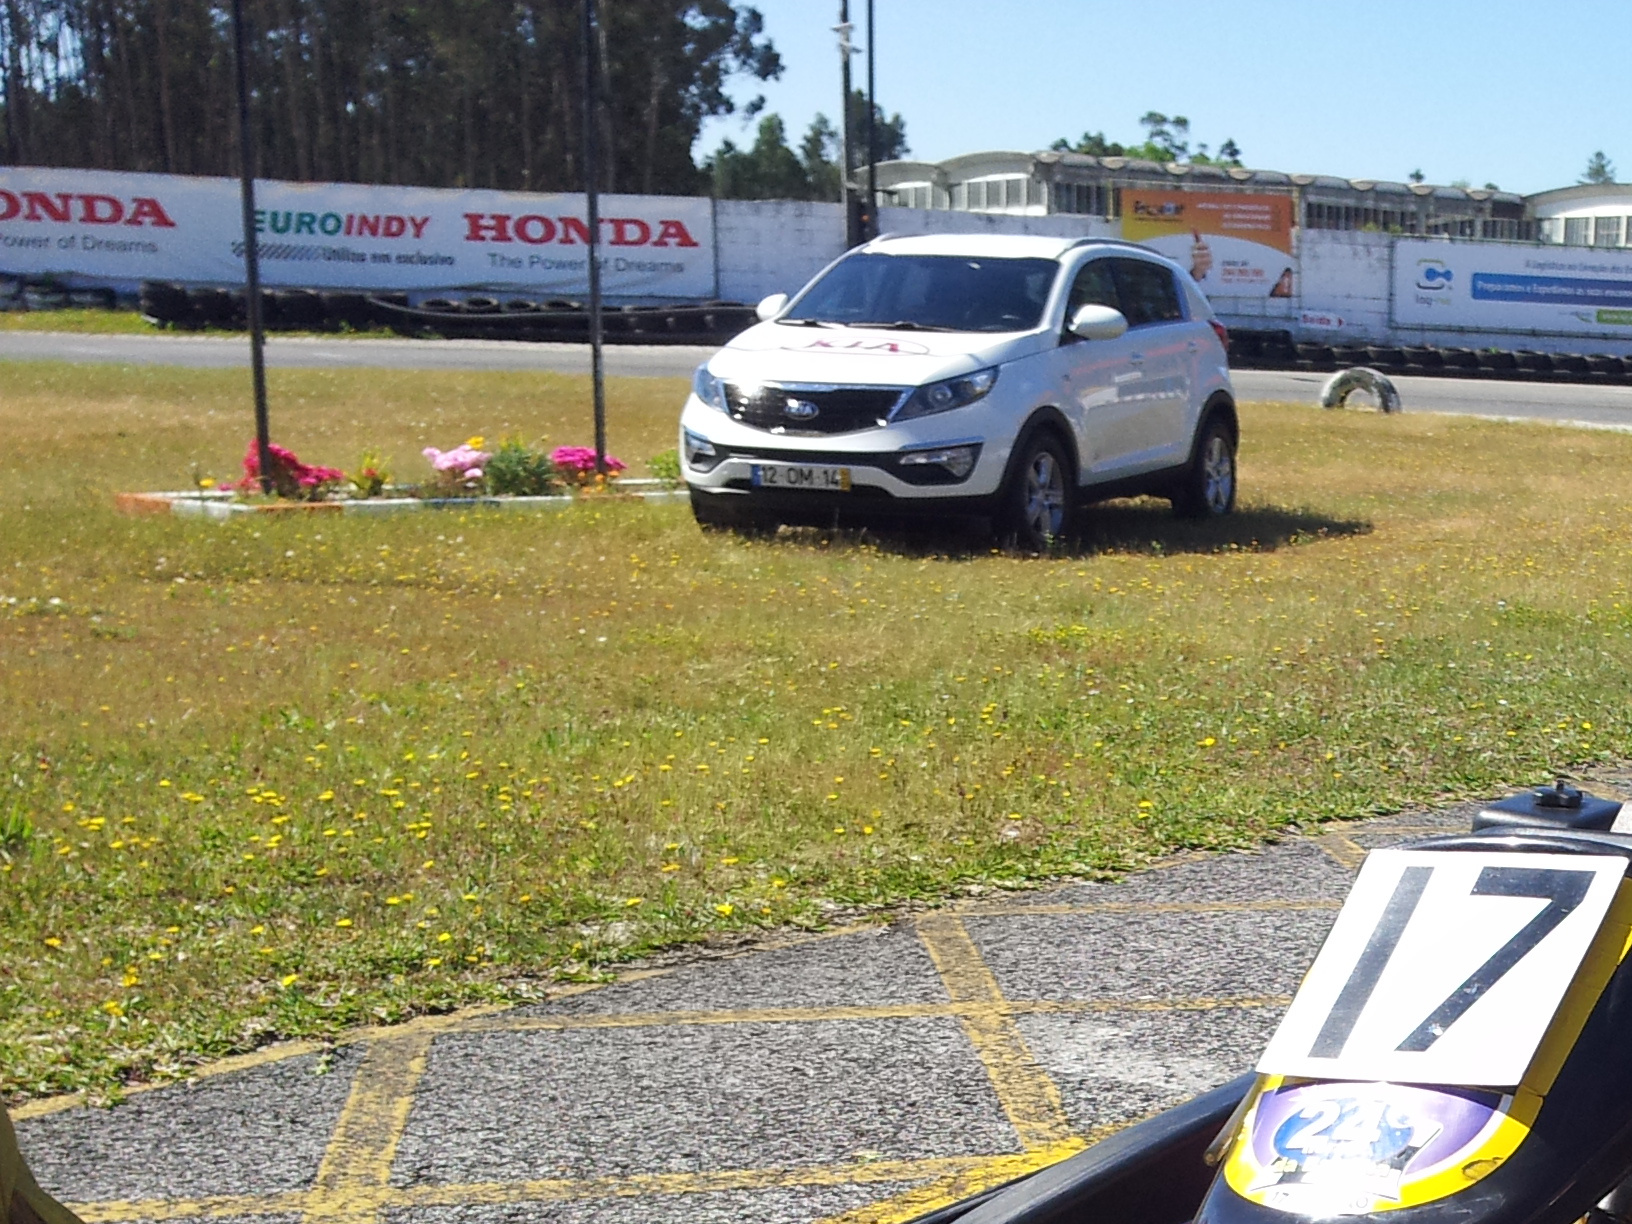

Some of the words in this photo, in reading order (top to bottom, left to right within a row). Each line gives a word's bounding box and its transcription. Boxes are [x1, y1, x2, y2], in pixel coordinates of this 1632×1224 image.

[253, 209, 432, 239] EUROINDY
[463, 212, 699, 247] HONDA
[0, 234, 49, 249] ower
[57, 235, 76, 249] of
[82, 234, 159, 252] Dreams
[487, 252, 522, 269] The
[528, 255, 585, 271] Power
[615, 257, 685, 273] Dreams
[1306, 865, 1598, 1060] 17
